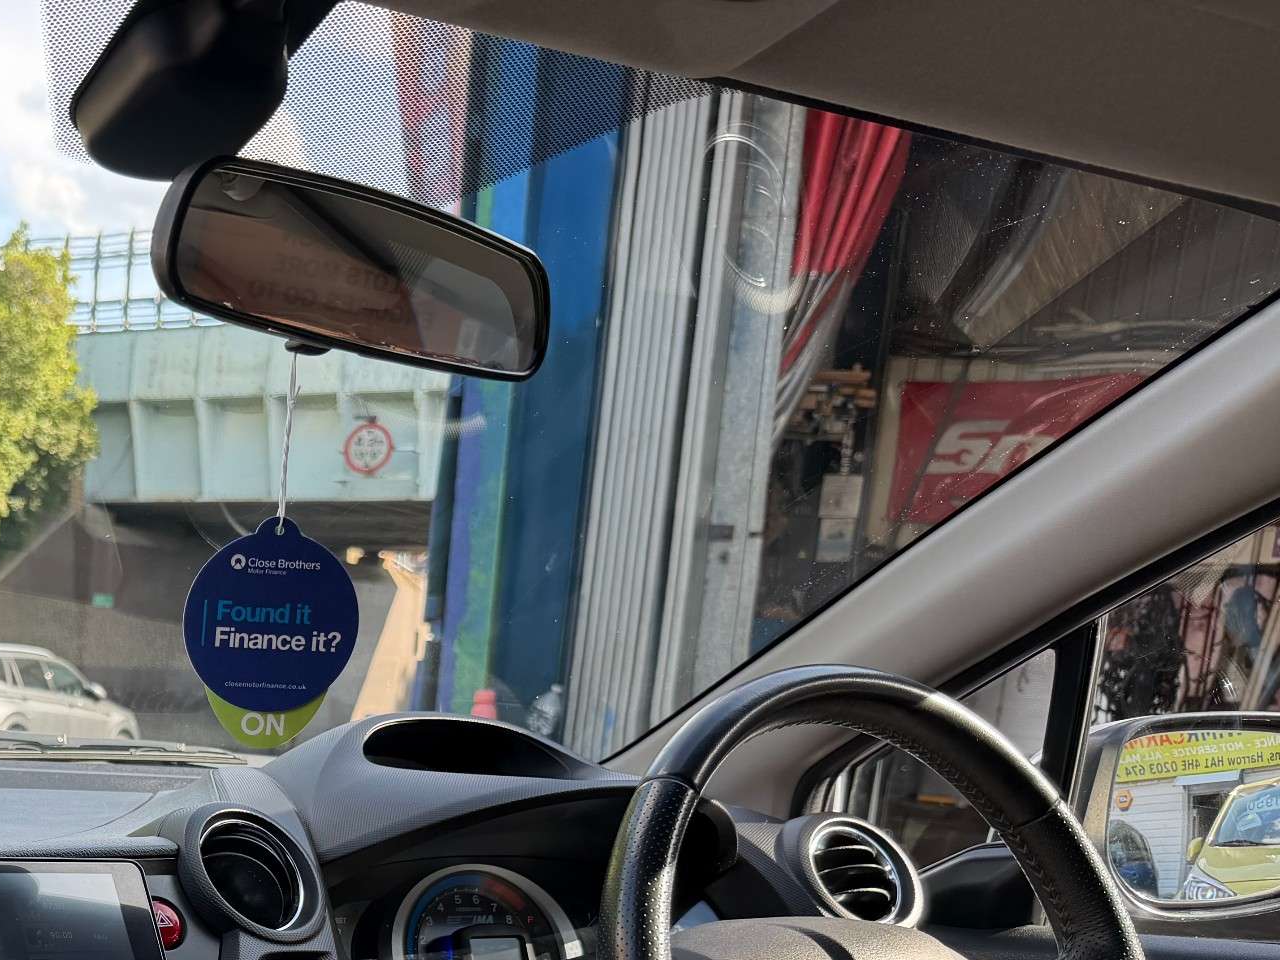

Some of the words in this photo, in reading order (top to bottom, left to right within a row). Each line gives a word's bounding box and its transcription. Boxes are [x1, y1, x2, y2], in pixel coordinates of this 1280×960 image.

[248, 557, 276, 568] Close
[278, 559, 321, 570] Brothers
[216, 600, 290, 625] Found
[295, 602, 312, 625] it
[214, 626, 306, 651] Finance
[311, 631, 342, 653] it?
[224, 680, 307, 691] closemotorfinance.co.uk
[240, 712, 285, 737] ON
[454, 895, 462, 904] 5
[472, 895, 480, 904] 6
[491, 903, 498, 912] 7
[505, 915, 513, 924] 8
